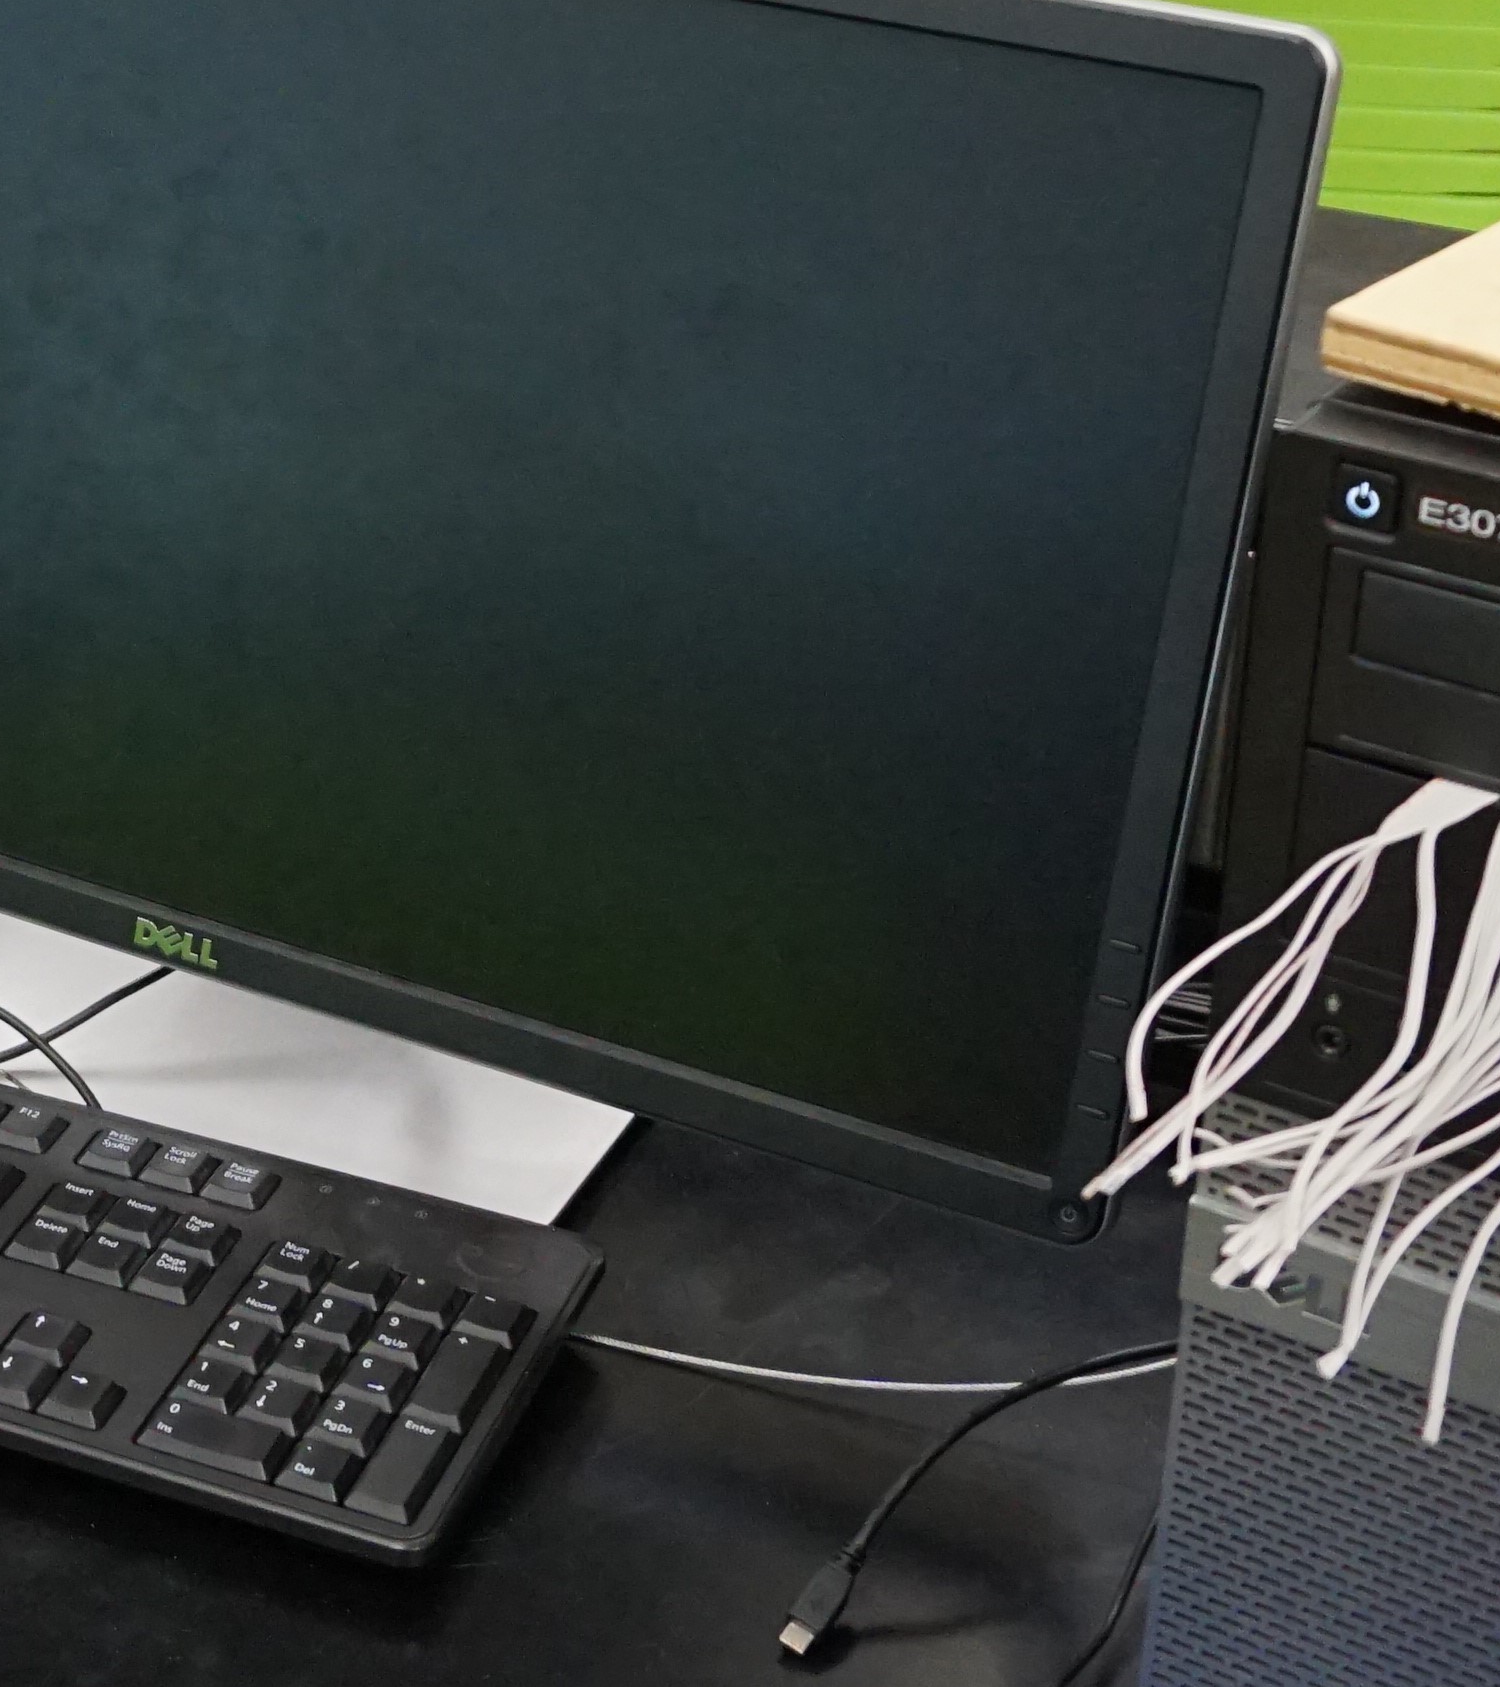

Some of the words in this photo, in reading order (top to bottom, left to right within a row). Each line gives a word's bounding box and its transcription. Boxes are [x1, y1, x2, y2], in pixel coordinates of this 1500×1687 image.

[133, 916, 218, 970] DELL
[19, 1106, 41, 1118] F12
[164, 1153, 188, 1165] Lock
[169, 1145, 198, 1159] Scroll
[230, 1162, 260, 1175] Pause
[223, 1170, 255, 1185] Break
[65, 1181, 95, 1197] Insert
[127, 1198, 158, 1214] Home
[35, 1218, 69, 1234] Delete
[185, 1221, 201, 1233] Up
[189, 1215, 216, 1230] Page
[98, 1236, 120, 1249] End
[285, 1240, 311, 1255] Num
[160, 1252, 187, 1266] Page
[280, 1248, 305, 1263] Lock
[155, 1258, 188, 1274] Down
[257, 1279, 270, 1290] 7
[245, 1296, 279, 1313] Home
[322, 1298, 334, 1309] 8
[229, 1319, 241, 1332] 4
[388, 1316, 401, 1328] 9
[294, 1338, 306, 1349] 5
[378, 1332, 409, 1351] PgUp
[201, 1361, 209, 1372] 1
[362, 1358, 374, 1369] 6
[187, 1378, 211, 1393] End
[265, 1380, 278, 1392] 2
[169, 1402, 182, 1414] 0
[334, 1399, 347, 1412] 3
[157, 1420, 174, 1435] Ins
[323, 1418, 354, 1436] PgDn
[405, 1419, 437, 1437] Enter
[295, 1462, 316, 1477] Del
